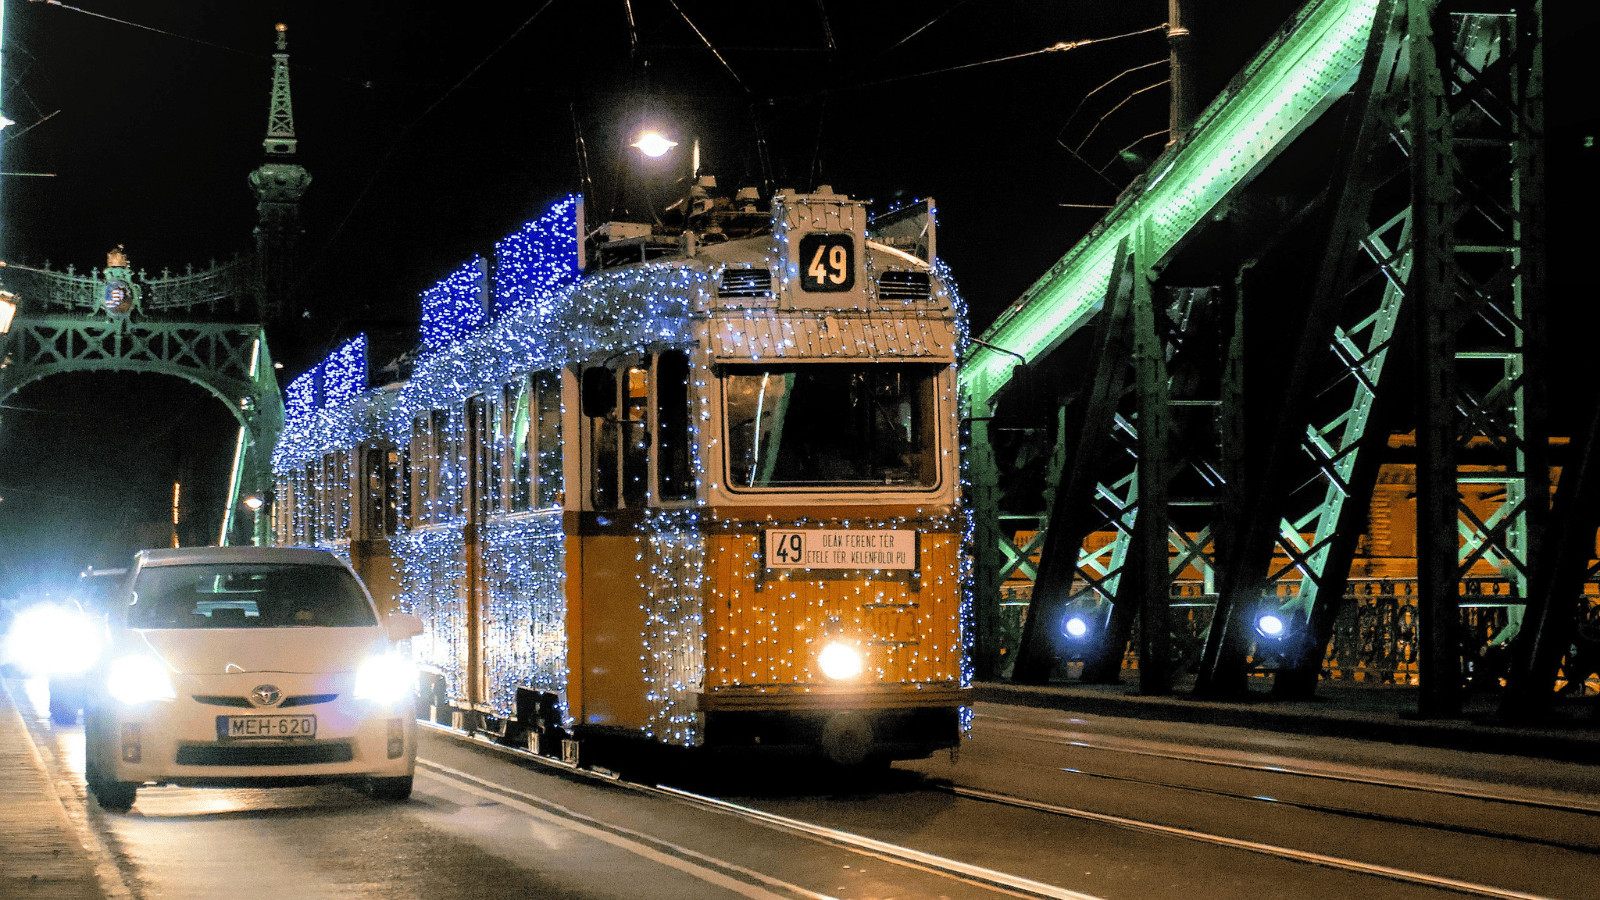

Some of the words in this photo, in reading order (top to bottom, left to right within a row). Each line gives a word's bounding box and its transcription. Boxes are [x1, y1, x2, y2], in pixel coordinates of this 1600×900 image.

[808, 244, 847, 285] 49
[776, 534, 803, 563] 49
[845, 534, 877, 548] FERENC
[807, 550, 829, 564] ETELE
[232, 719, 311, 735] MEH-620
